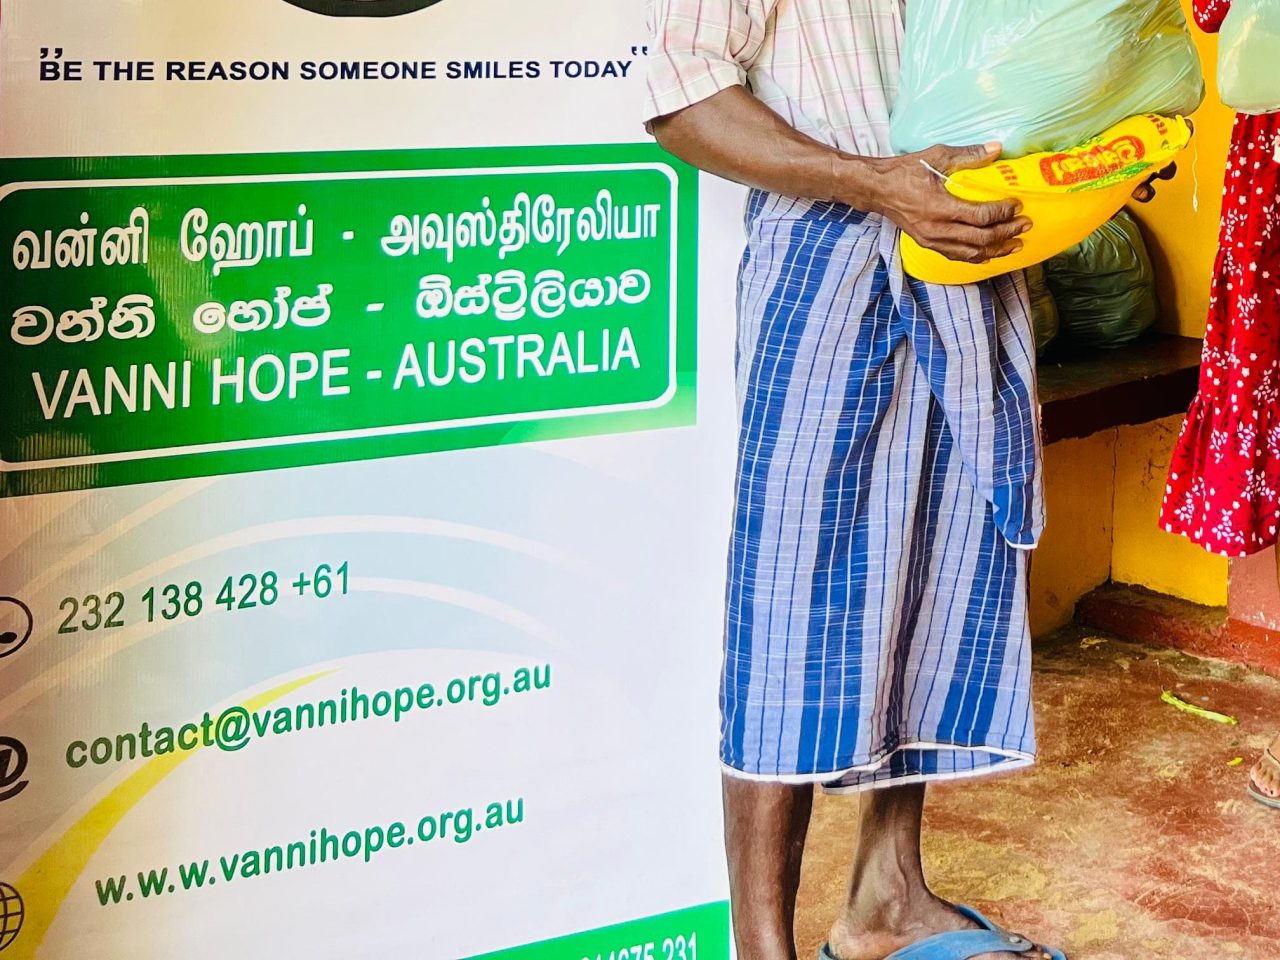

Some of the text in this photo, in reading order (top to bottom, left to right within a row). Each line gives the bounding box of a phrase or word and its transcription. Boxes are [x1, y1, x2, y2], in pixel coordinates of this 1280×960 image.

[92, 61, 155, 81] THE
[165, 61, 290, 81] REASON
[299, 61, 437, 81] SOMEONE
[445, 60, 542, 80] SMILES
[12, 206, 149, 270] வன்னி
[180, 203, 314, 277] ஹோப்
[380, 188, 661, 263] அவுஸ்திரேலியா
[10, 293, 156, 346] වන්නි
[31, 360, 192, 420] VANNI
[212, 348, 351, 405] HOPE
[393, 327, 641, 390] AUSTRALIA
[57, 560, 351, 635] 232 138 428 +61
[65, 664, 553, 769] contact@vannihope.org.au
[95, 795, 525, 907] w.w.w.vannihope.org.au
